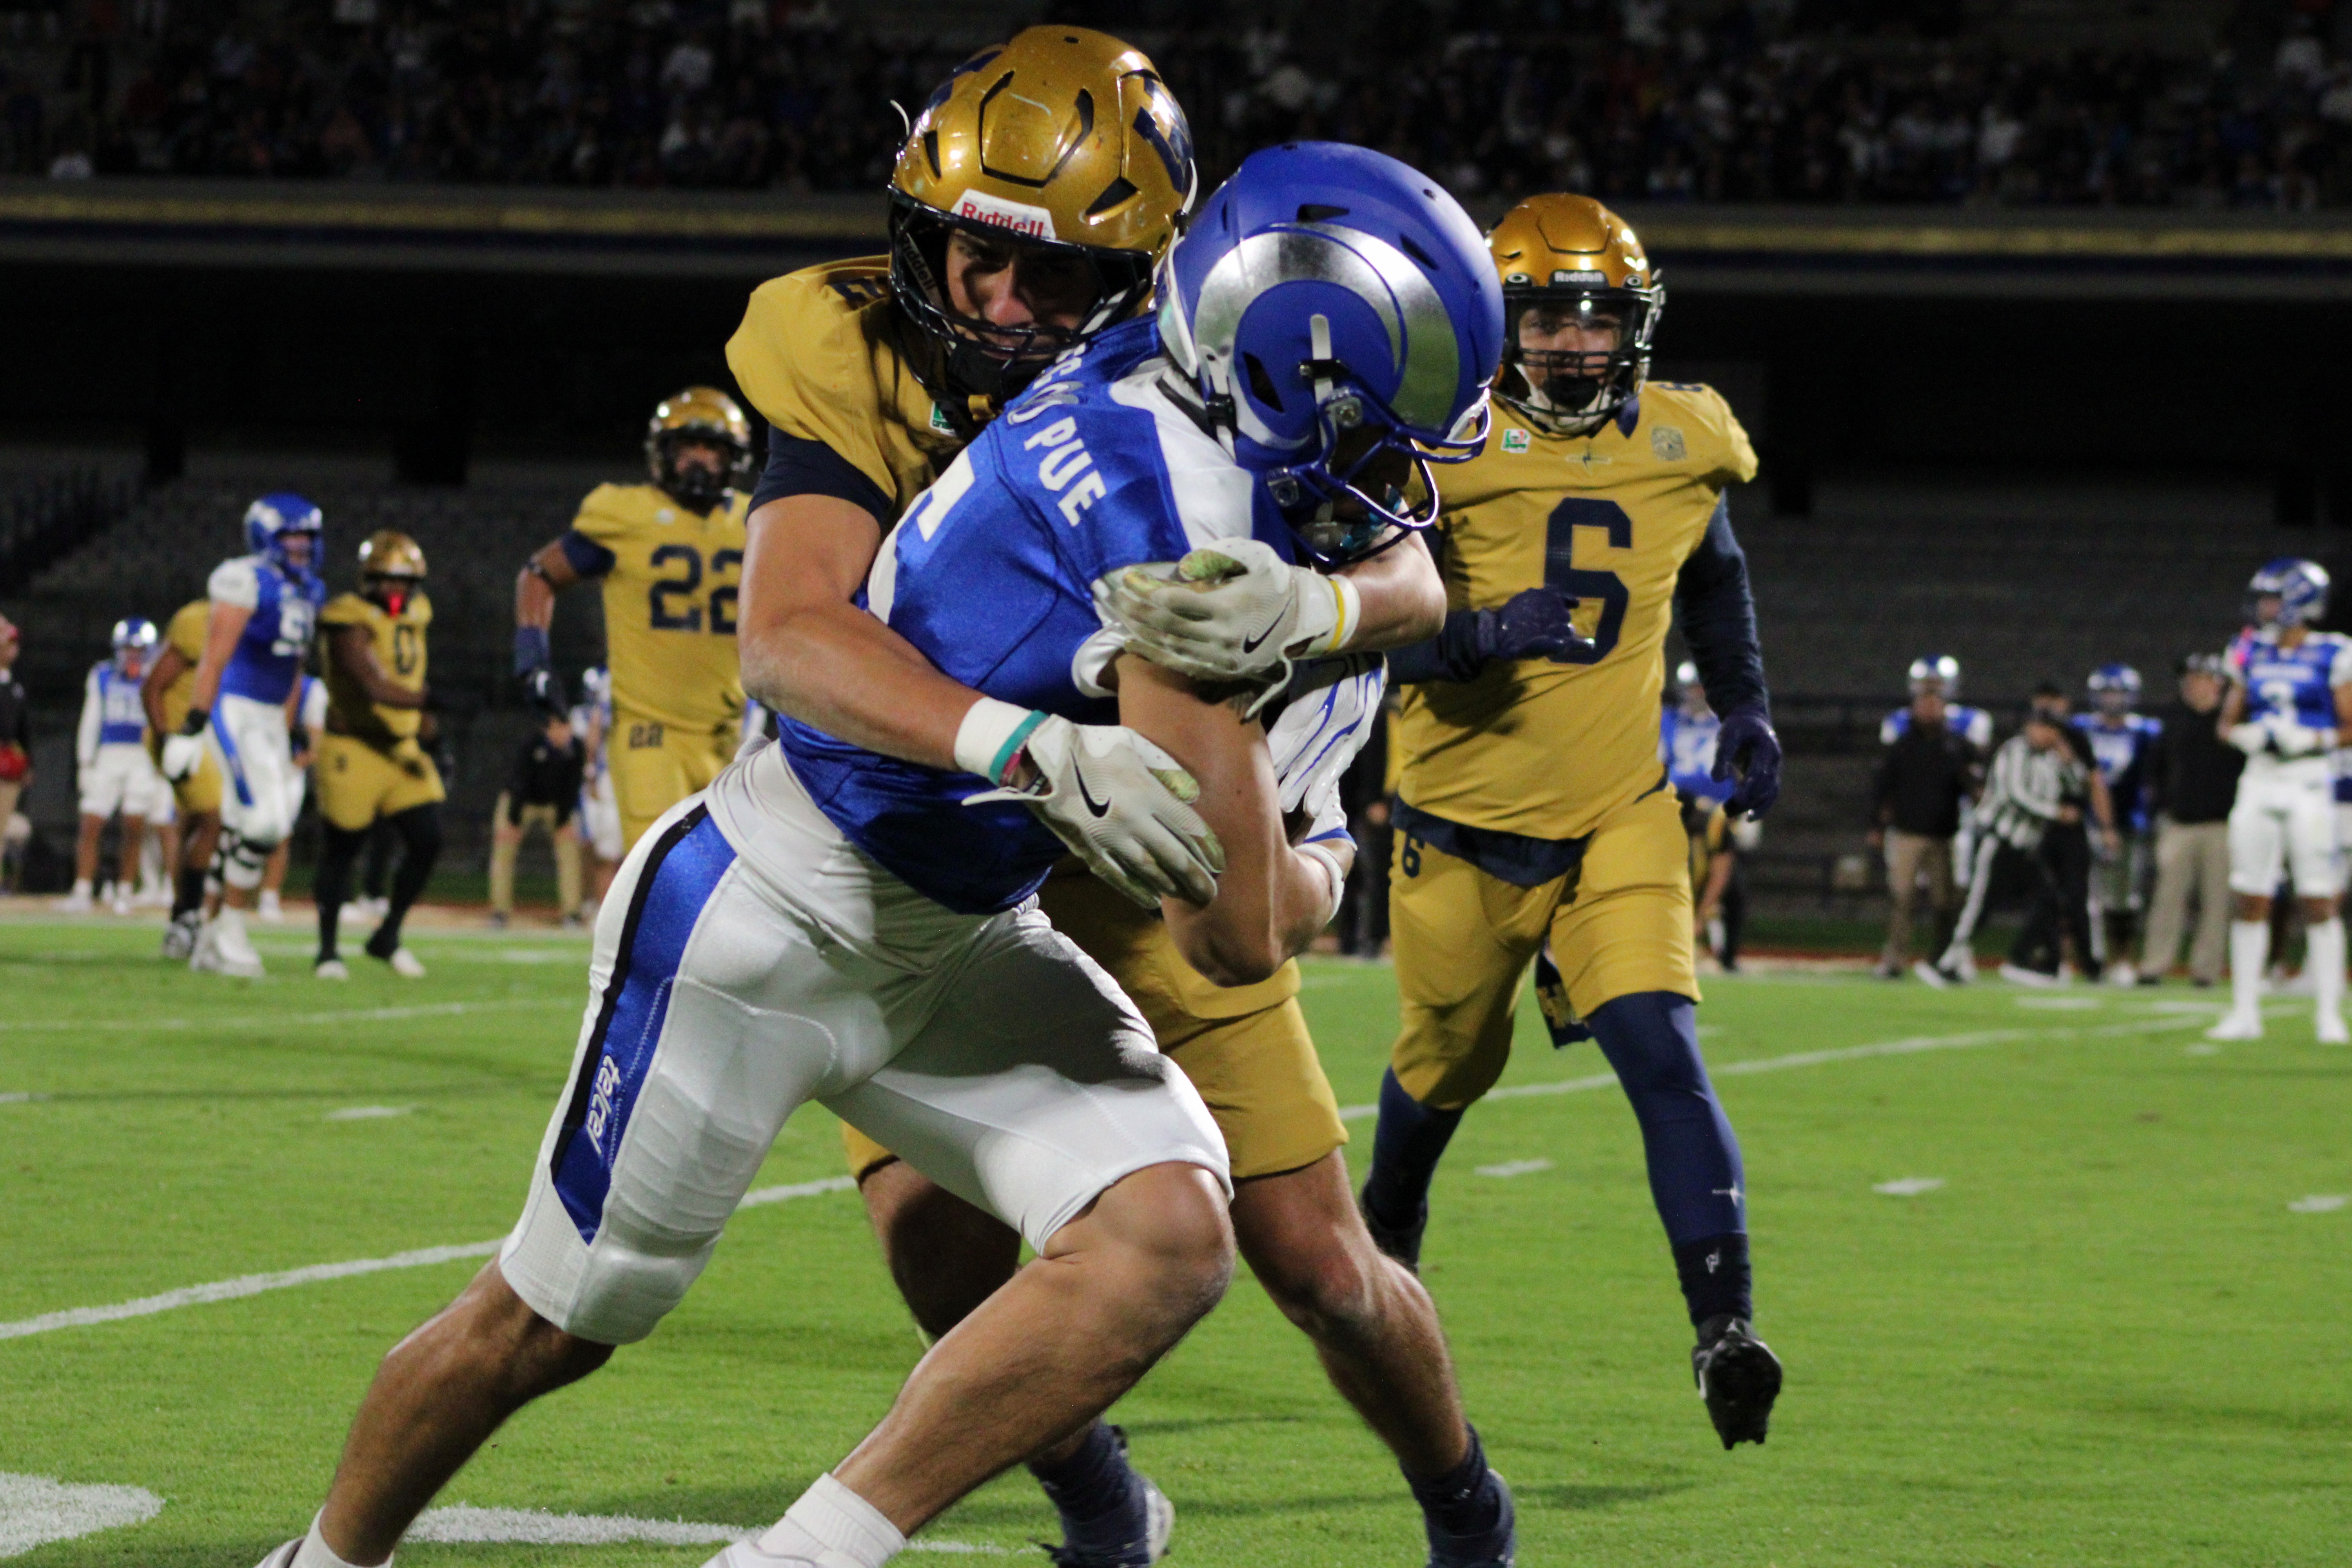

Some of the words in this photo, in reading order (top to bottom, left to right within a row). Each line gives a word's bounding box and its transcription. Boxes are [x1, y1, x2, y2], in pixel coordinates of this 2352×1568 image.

[961, 201, 1044, 237] Riddell
[1024, 416, 1107, 527] PUE
[649, 544, 744, 634] 22
[1544, 497, 1632, 665] 6
[1402, 828, 1425, 878] 6
[586, 1055, 621, 1155] telcel
